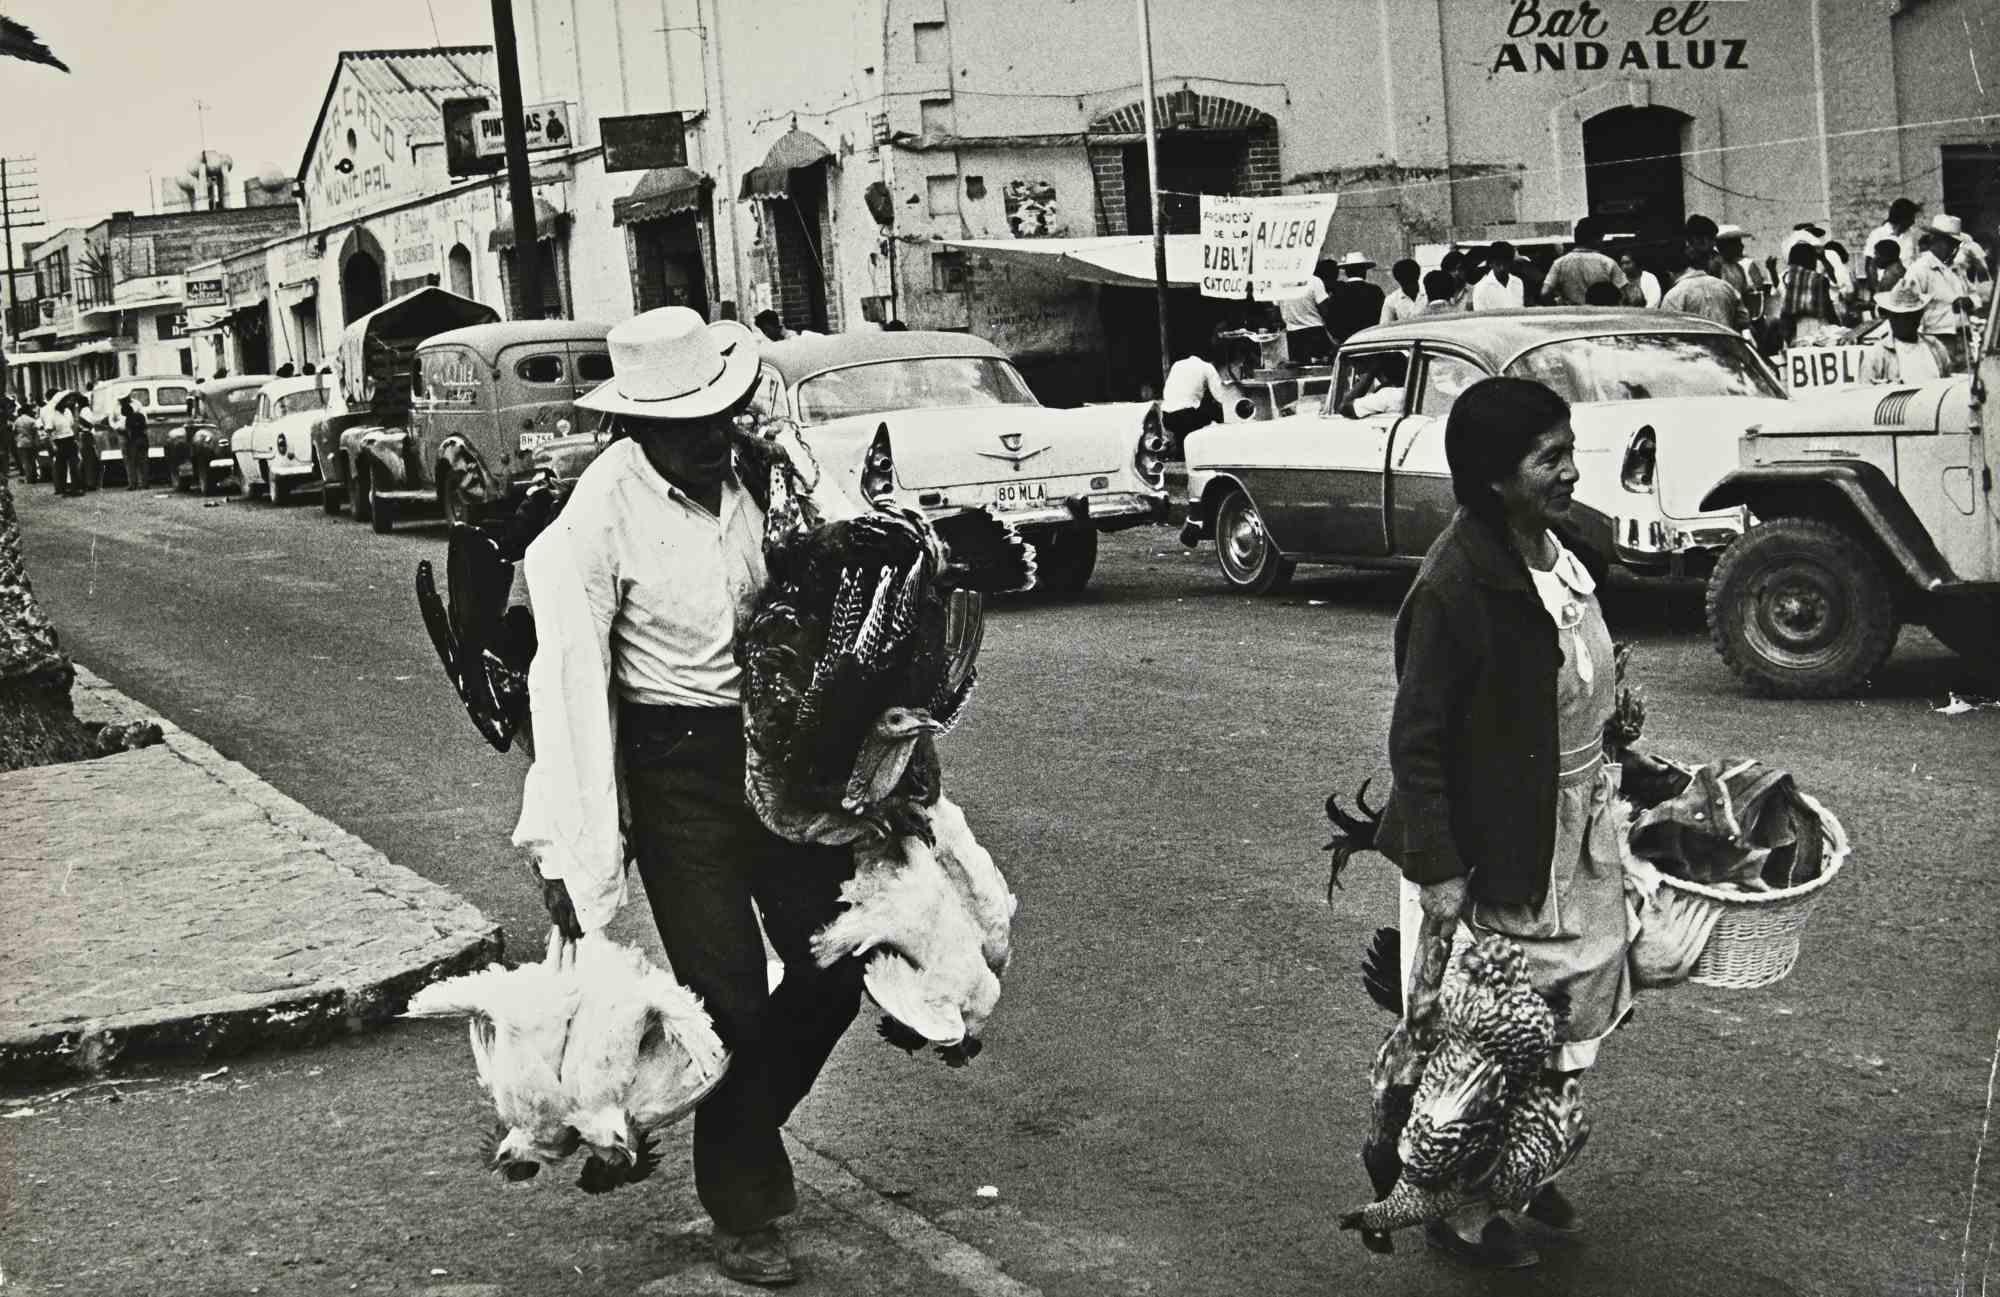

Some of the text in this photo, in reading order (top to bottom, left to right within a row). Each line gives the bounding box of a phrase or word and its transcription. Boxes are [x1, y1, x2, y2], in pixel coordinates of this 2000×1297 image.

[1507, 0, 1710, 38] Bar el
[1493, 39, 1749, 73] ANDALUZ
[314, 86, 395, 196] MERCADO
[481, 112, 541, 138] PINAS
[326, 163, 391, 205] MUNICIPAL
[999, 484, 1044, 501] 80 MLA
